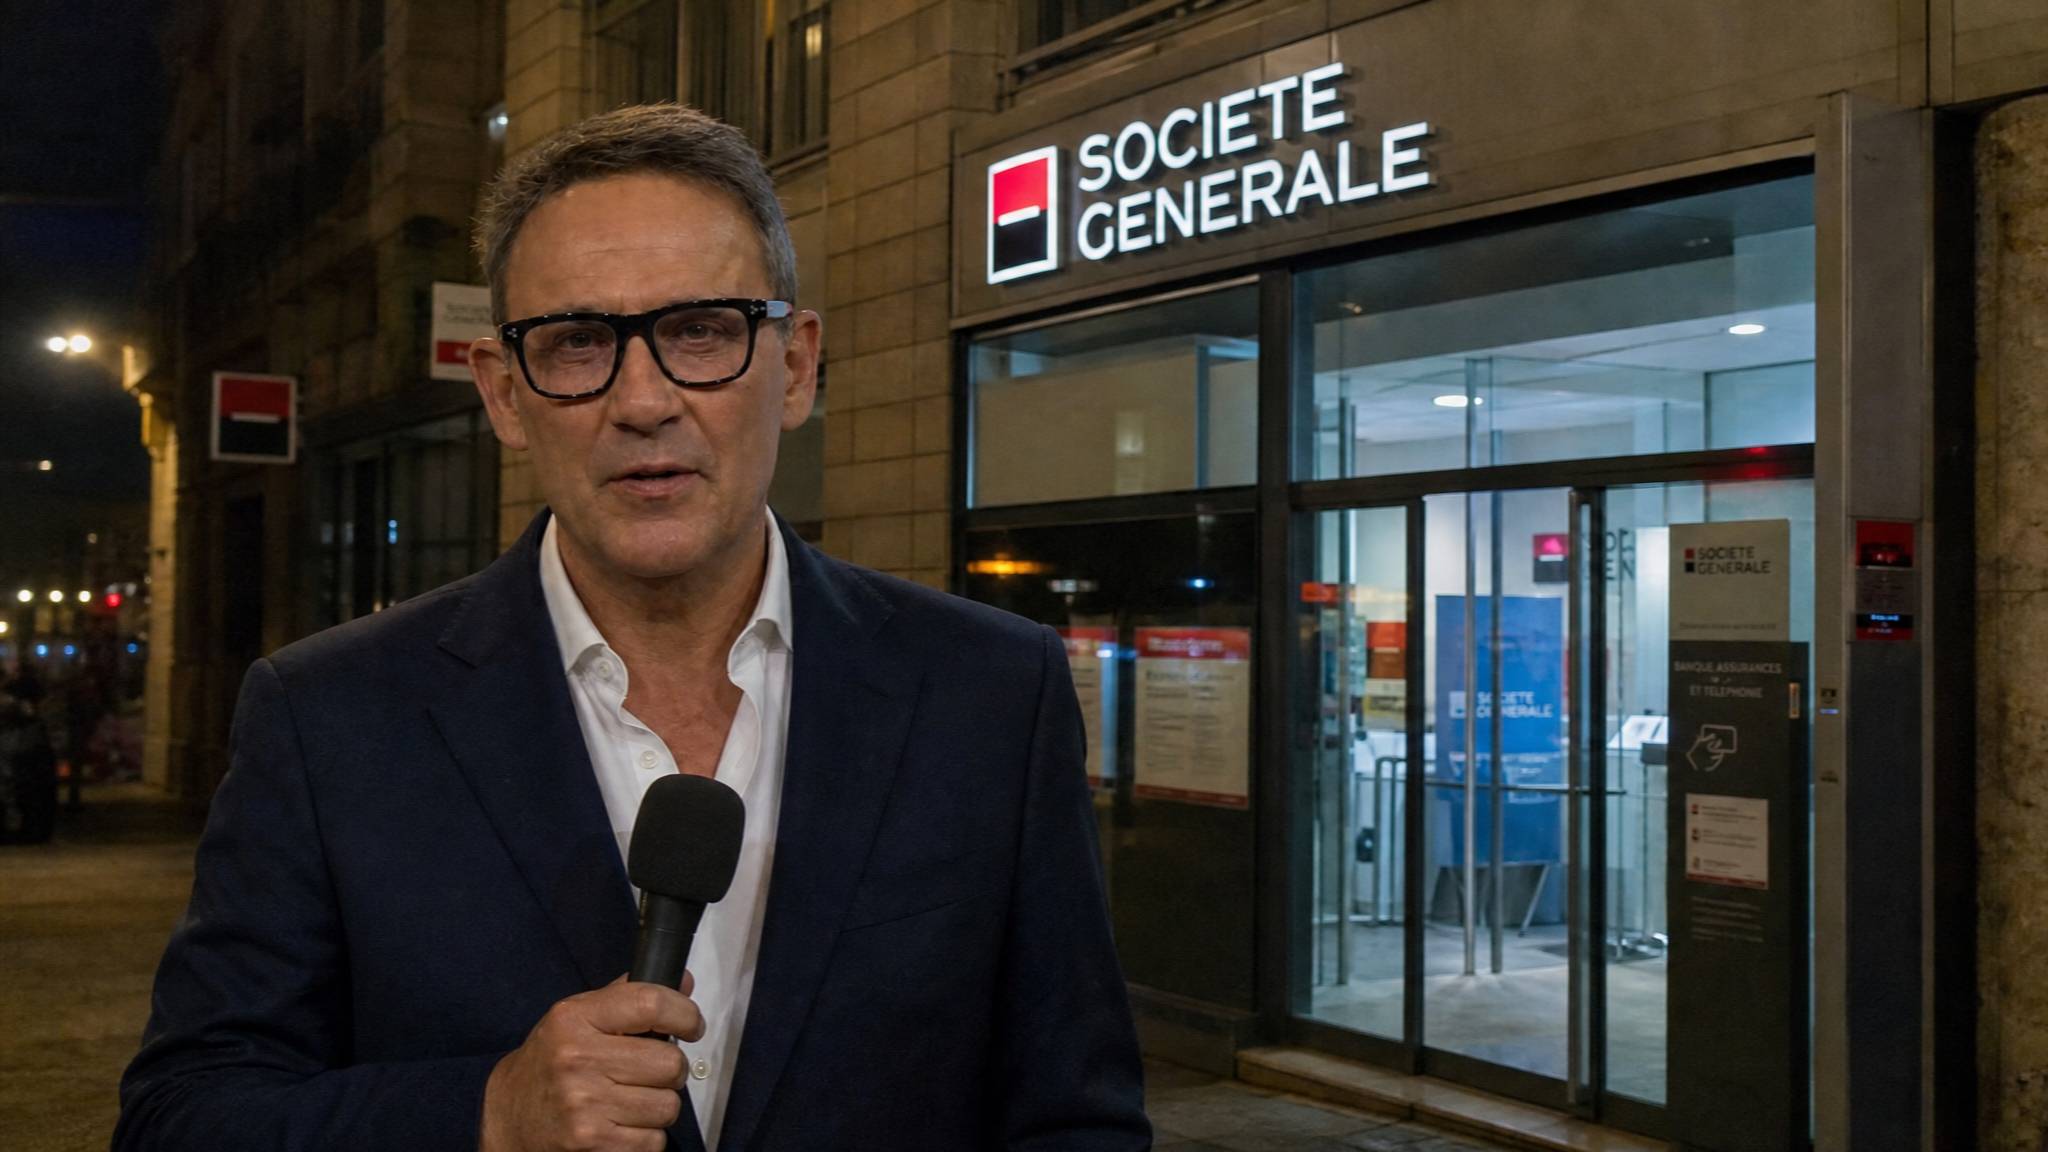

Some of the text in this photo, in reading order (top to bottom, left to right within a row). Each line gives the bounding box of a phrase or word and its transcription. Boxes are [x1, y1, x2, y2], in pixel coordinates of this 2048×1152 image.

[1078, 61, 1346, 193] SOCIETE
[1076, 121, 1430, 262] GENERALE
[1697, 546, 1755, 560] SOCIETE
[1697, 560, 1771, 575] GENERALE
